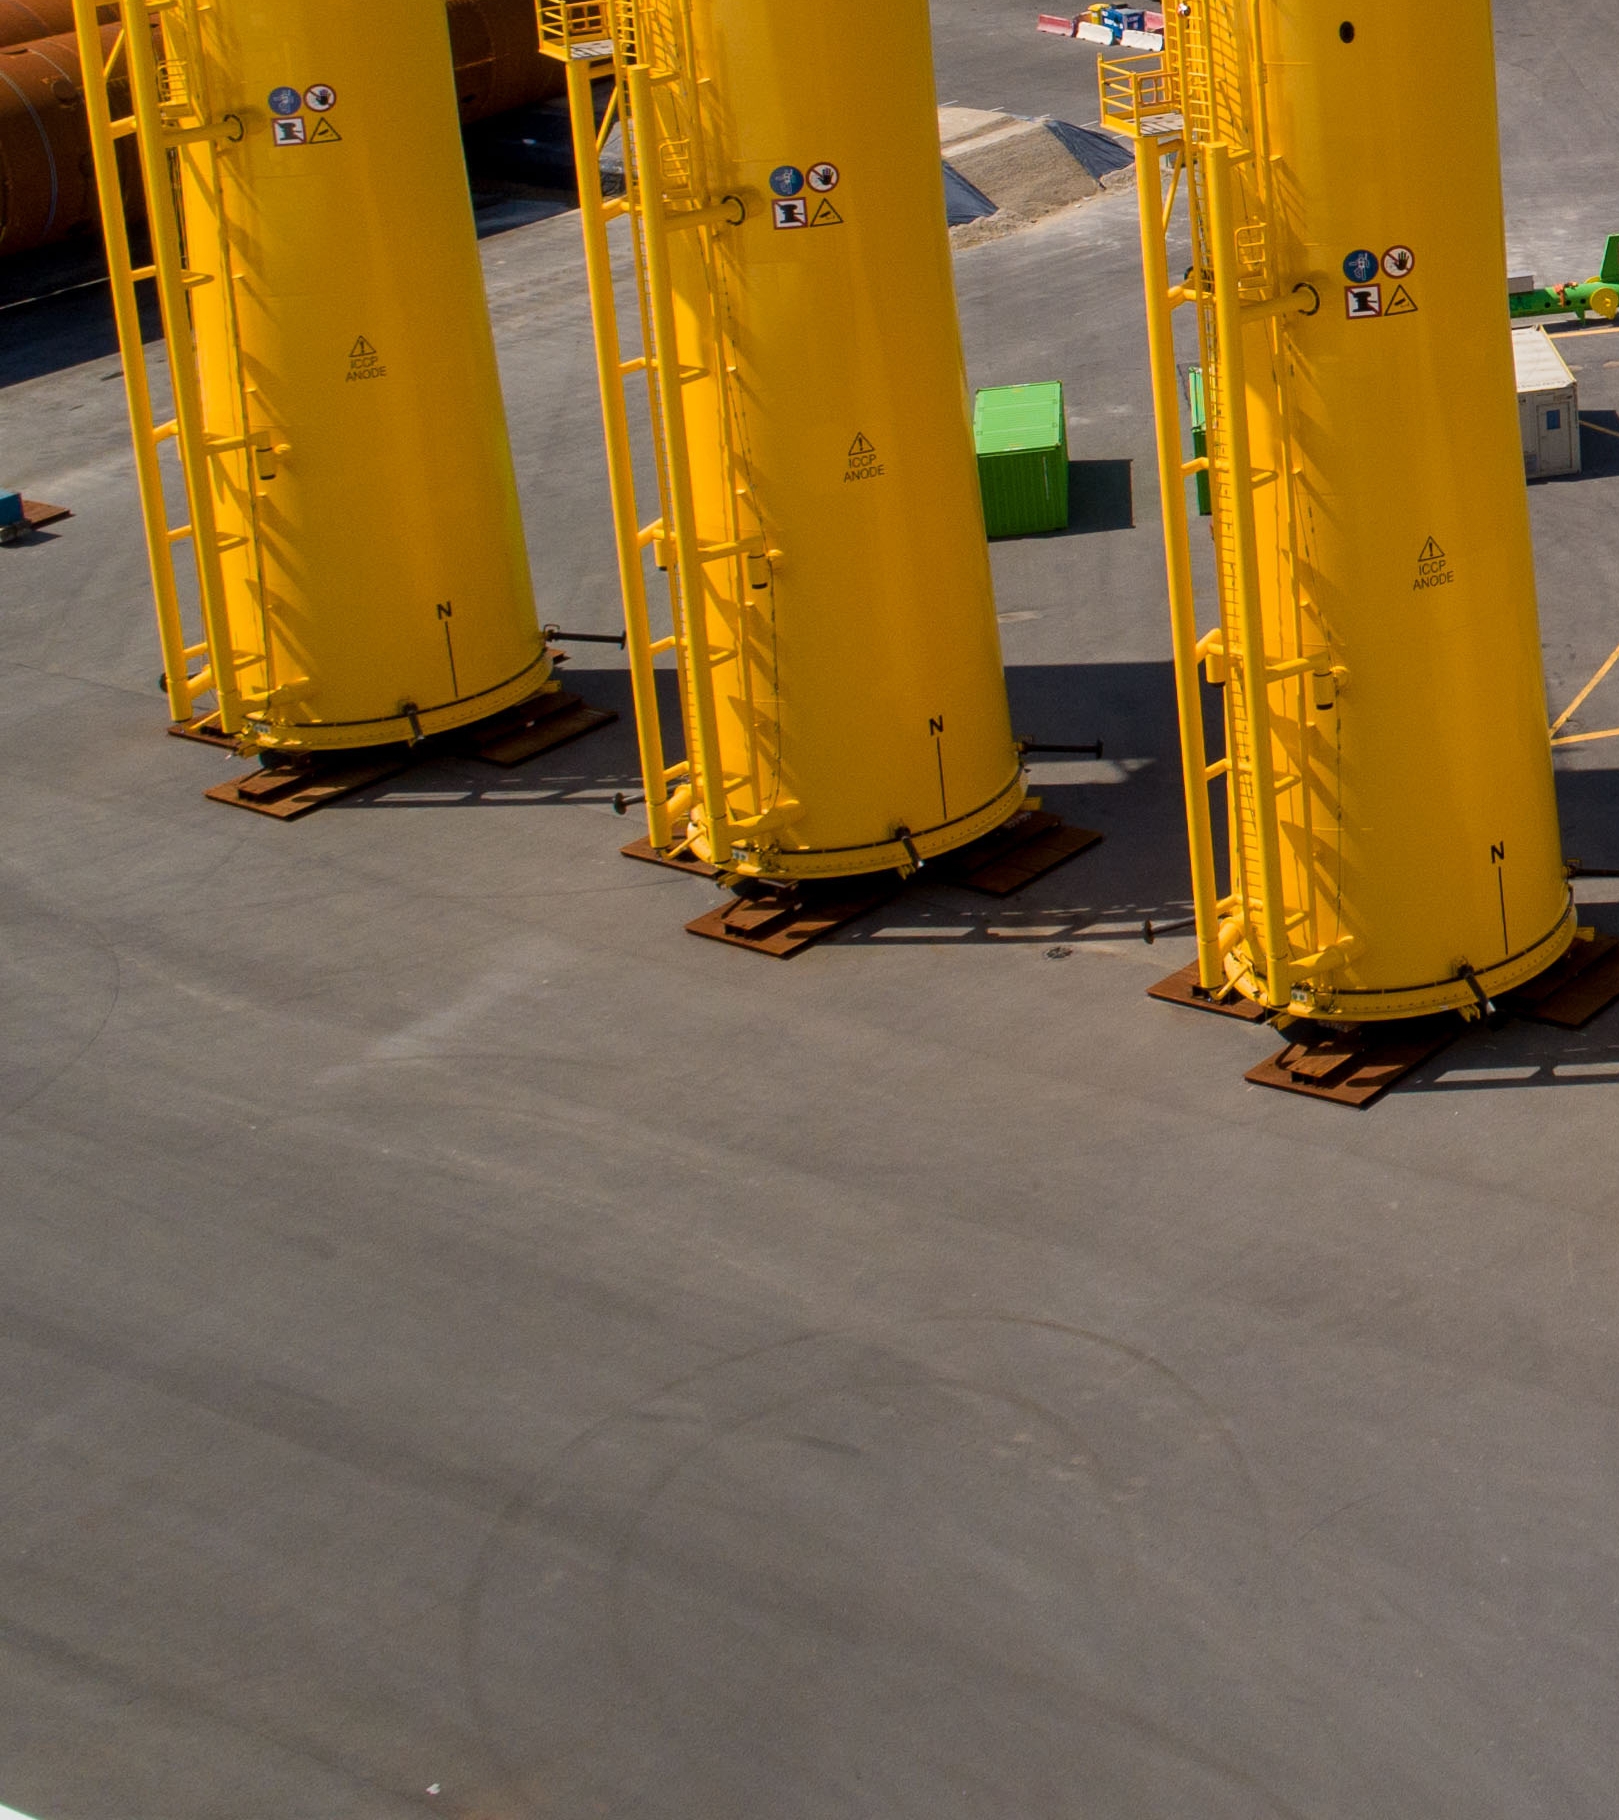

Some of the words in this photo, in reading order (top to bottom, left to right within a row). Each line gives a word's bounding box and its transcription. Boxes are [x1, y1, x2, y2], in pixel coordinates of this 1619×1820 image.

[350, 356, 378, 369] ICCP
[346, 366, 387, 383] ANODE
[849, 453, 877, 469] ICCP
[844, 464, 885, 483] ANODE
[1418, 560, 1446, 576] ICCP
[1413, 570, 1454, 591] ANODE
[437, 600, 452, 620] N
[929, 714, 944, 736] N
[1491, 840, 1505, 864] N
